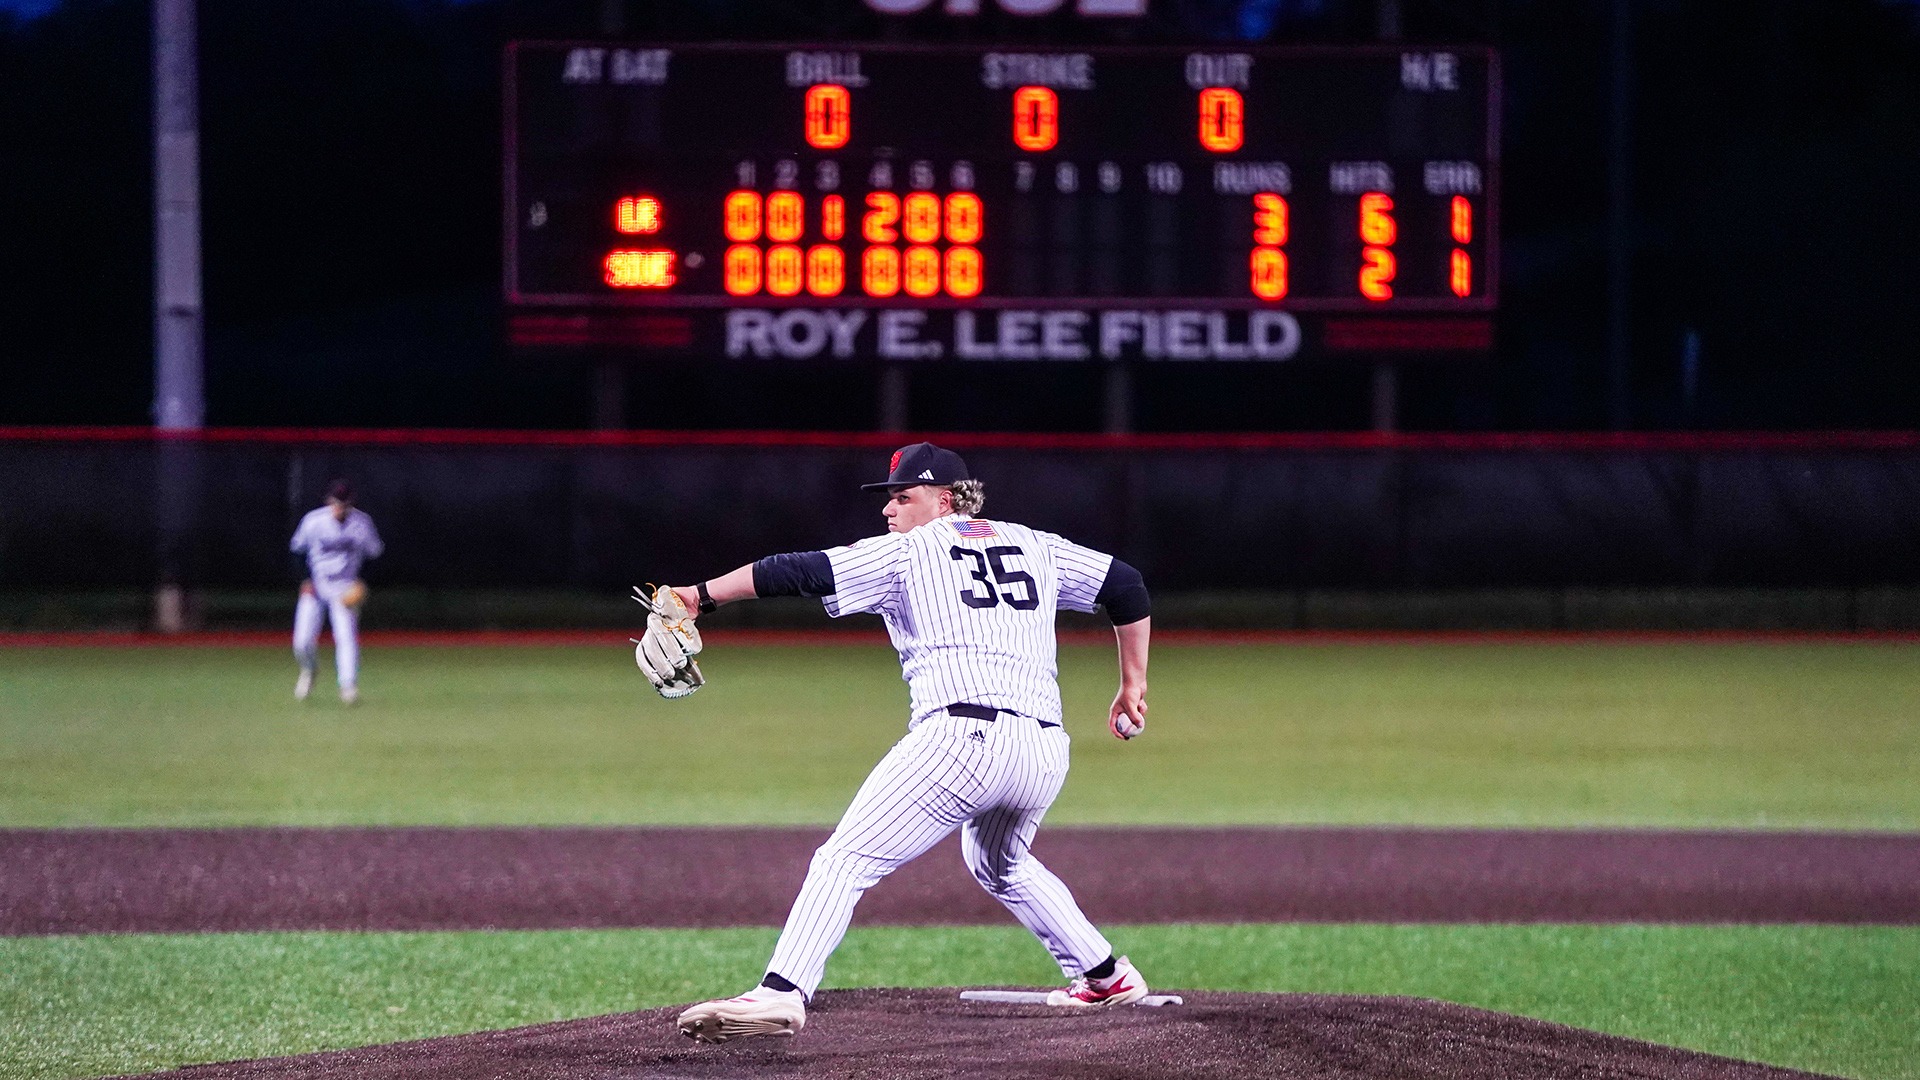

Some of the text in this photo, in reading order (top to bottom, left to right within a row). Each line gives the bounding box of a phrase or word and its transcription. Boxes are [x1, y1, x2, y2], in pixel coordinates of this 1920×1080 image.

[805, 83, 851, 148] 0
[1013, 86, 1059, 151] 0
[1199, 88, 1244, 152] 0
[774, 159, 798, 189] 2
[815, 159, 840, 190] 3
[910, 159, 935, 190] 5
[1253, 192, 1288, 246] 3
[1451, 195, 1472, 244] 1
[1250, 246, 1288, 300] 0
[1359, 246, 1397, 300] 2
[1450, 248, 1471, 298] 1
[725, 309, 1300, 361] ROY E. LEE FIELD
[949, 546, 1040, 611] 35
